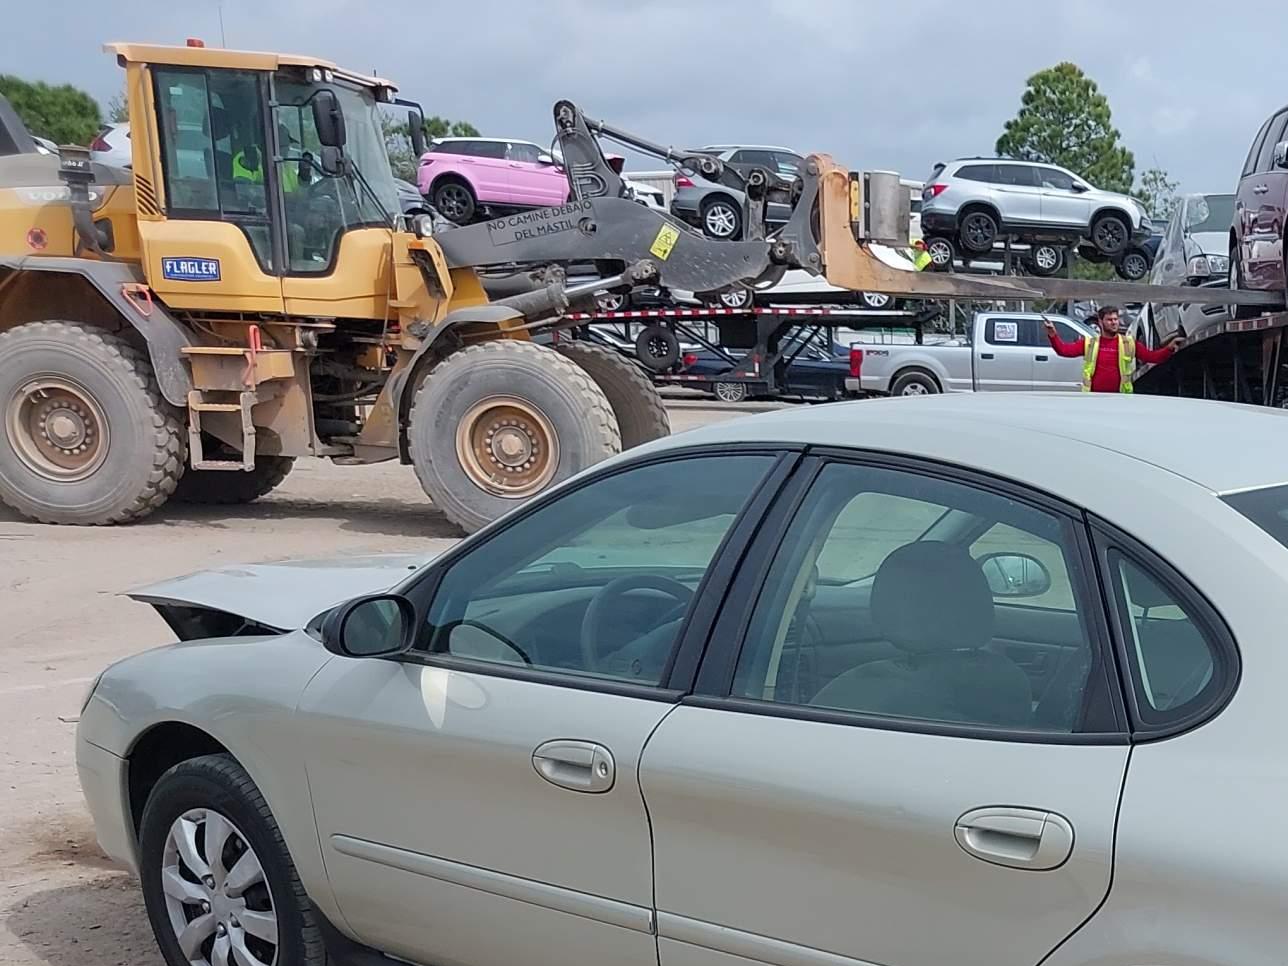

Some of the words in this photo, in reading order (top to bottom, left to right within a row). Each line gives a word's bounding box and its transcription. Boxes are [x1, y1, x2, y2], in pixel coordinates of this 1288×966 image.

[488, 220, 506, 232] NO
[508, 211, 550, 227] CAMINE
[551, 200, 592, 217] DEBAJO
[514, 229, 535, 241] DEL
[165, 261, 217, 275] FLAGLER
